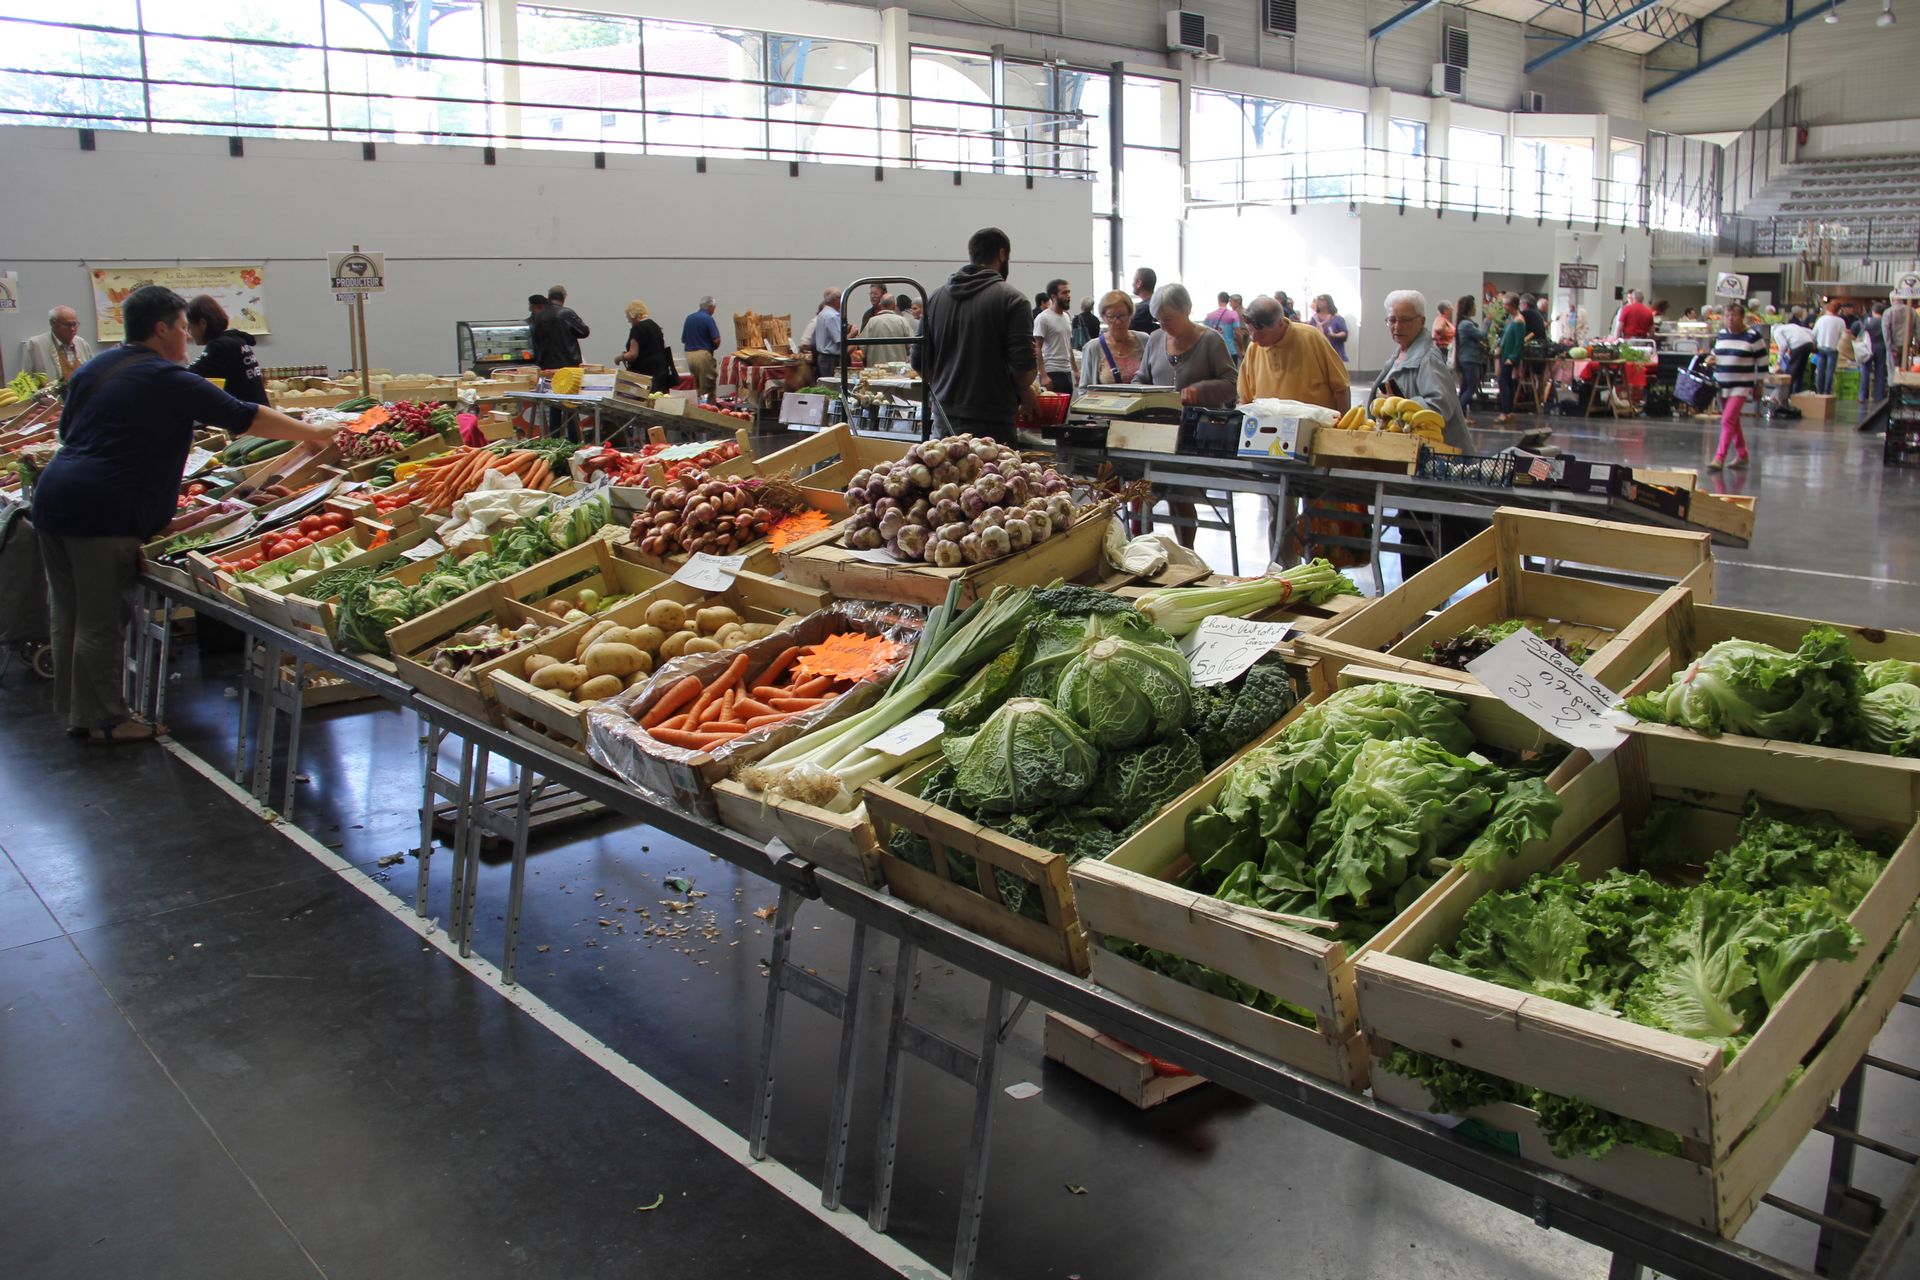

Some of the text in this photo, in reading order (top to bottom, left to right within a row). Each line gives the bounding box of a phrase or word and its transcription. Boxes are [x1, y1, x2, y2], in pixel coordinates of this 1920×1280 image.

[336, 277, 379, 287] PRODUCTEUR
[1521, 637, 1611, 702] Salade au
[1539, 671, 1572, 696] 0,70
